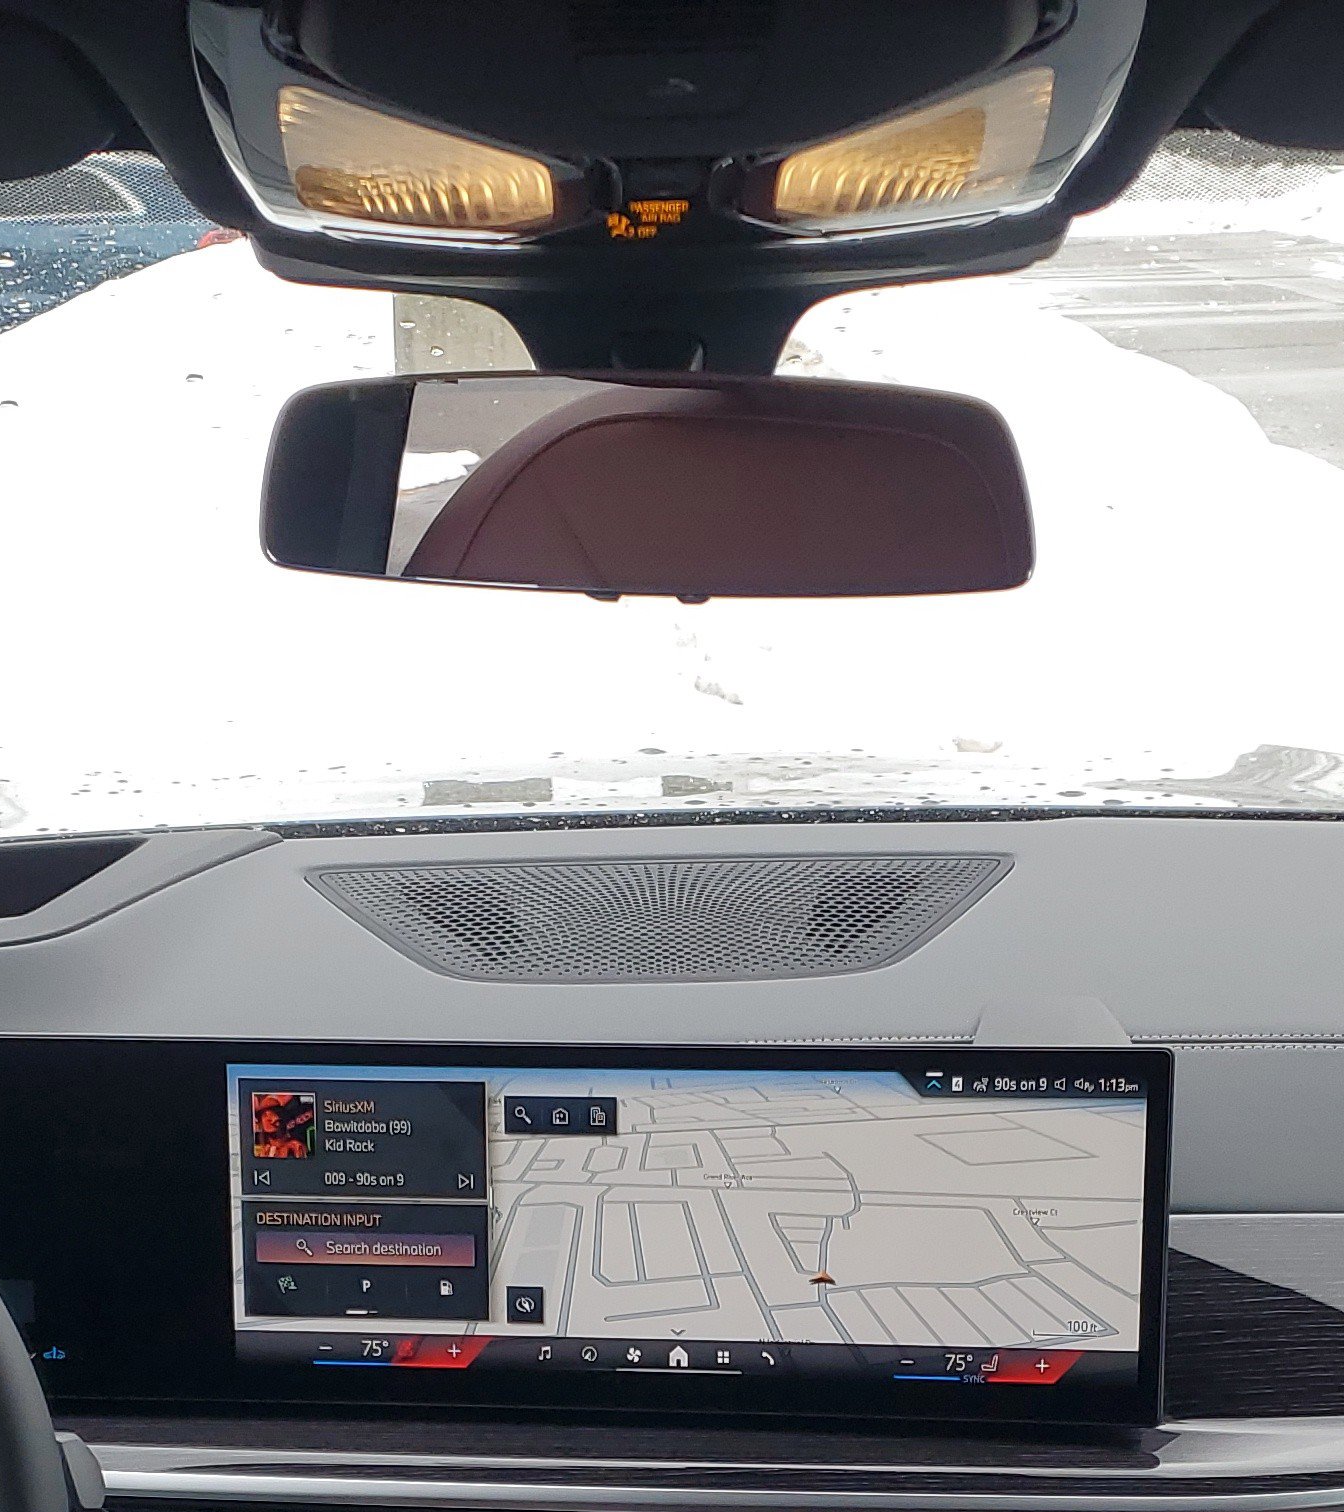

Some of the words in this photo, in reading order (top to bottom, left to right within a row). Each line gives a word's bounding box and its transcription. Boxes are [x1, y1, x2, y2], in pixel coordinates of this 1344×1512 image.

[994, 1077, 1017, 1091] 90s
[1020, 1079, 1036, 1091] on
[1039, 1077, 1047, 1091] 9
[324, 1100, 375, 1114] SiriusXM
[389, 1120, 412, 1136] (99)
[325, 1139, 344, 1152] Kid
[346, 1139, 375, 1152] Rock
[324, 1172, 346, 1186] 009
[356, 1172, 378, 1186] 90s
[379, 1175, 395, 1187] on
[396, 1173, 405, 1187] 9
[257, 1212, 341, 1226] DESTINATION
[343, 1213, 382, 1227] INPUT
[326, 1240, 369, 1255] Search
[373, 1241, 441, 1256] destination
[362, 1279, 372, 1292] P
[1067, 1320, 1088, 1332] 100
[1090, 1322, 1098, 1332] ft
[962, 1374, 986, 1385] SYNC
